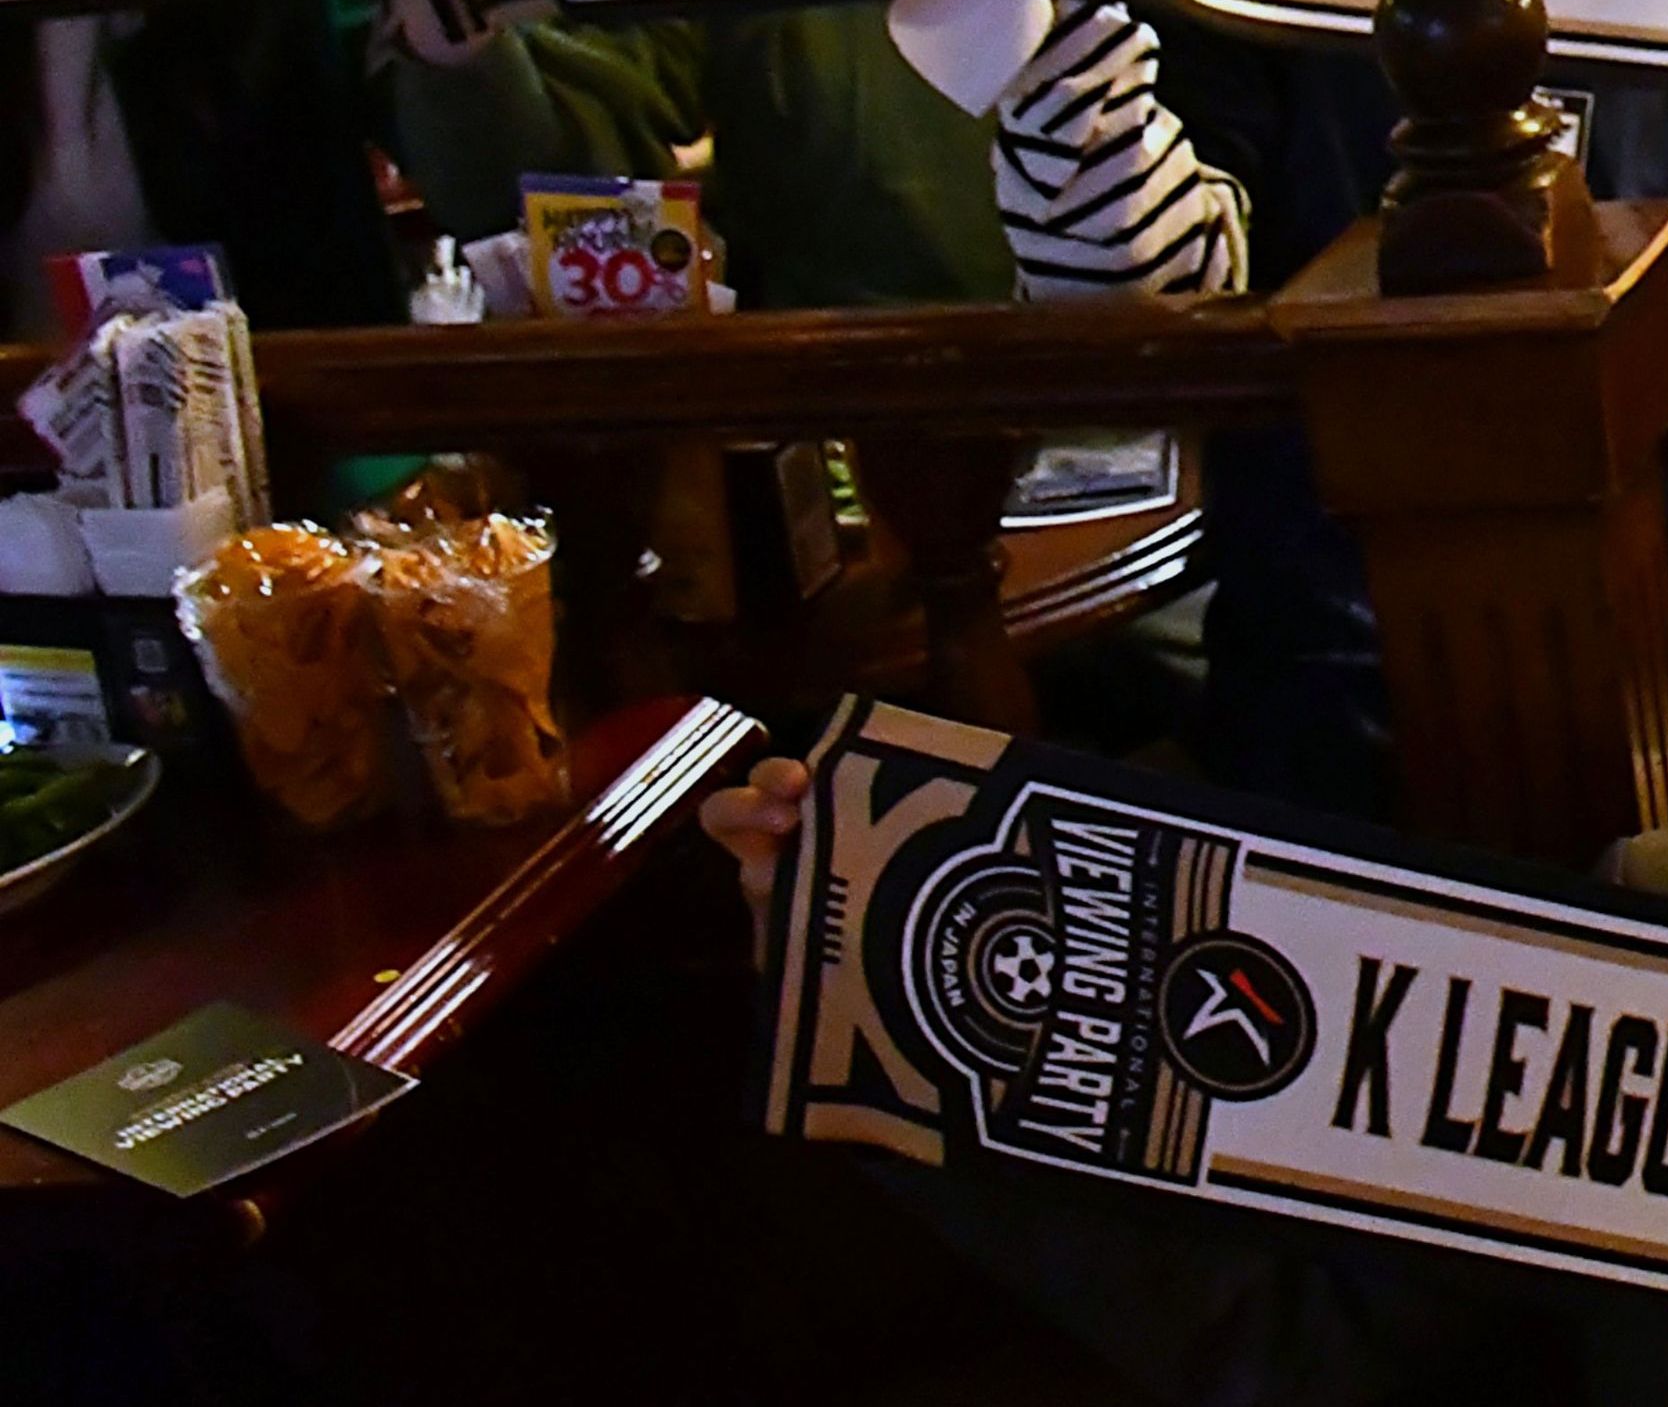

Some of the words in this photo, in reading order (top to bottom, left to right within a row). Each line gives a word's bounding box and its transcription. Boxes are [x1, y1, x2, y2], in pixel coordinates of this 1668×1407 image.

[942, 927, 966, 1008] JAPAN
[953, 900, 977, 928] IN
[1050, 818, 1140, 1005] VIEWING
[1120, 882, 1160, 1110] INTERNATIONAL
[1331, 954, 1419, 1138] K
[1018, 1010, 1123, 1154] PARTY
